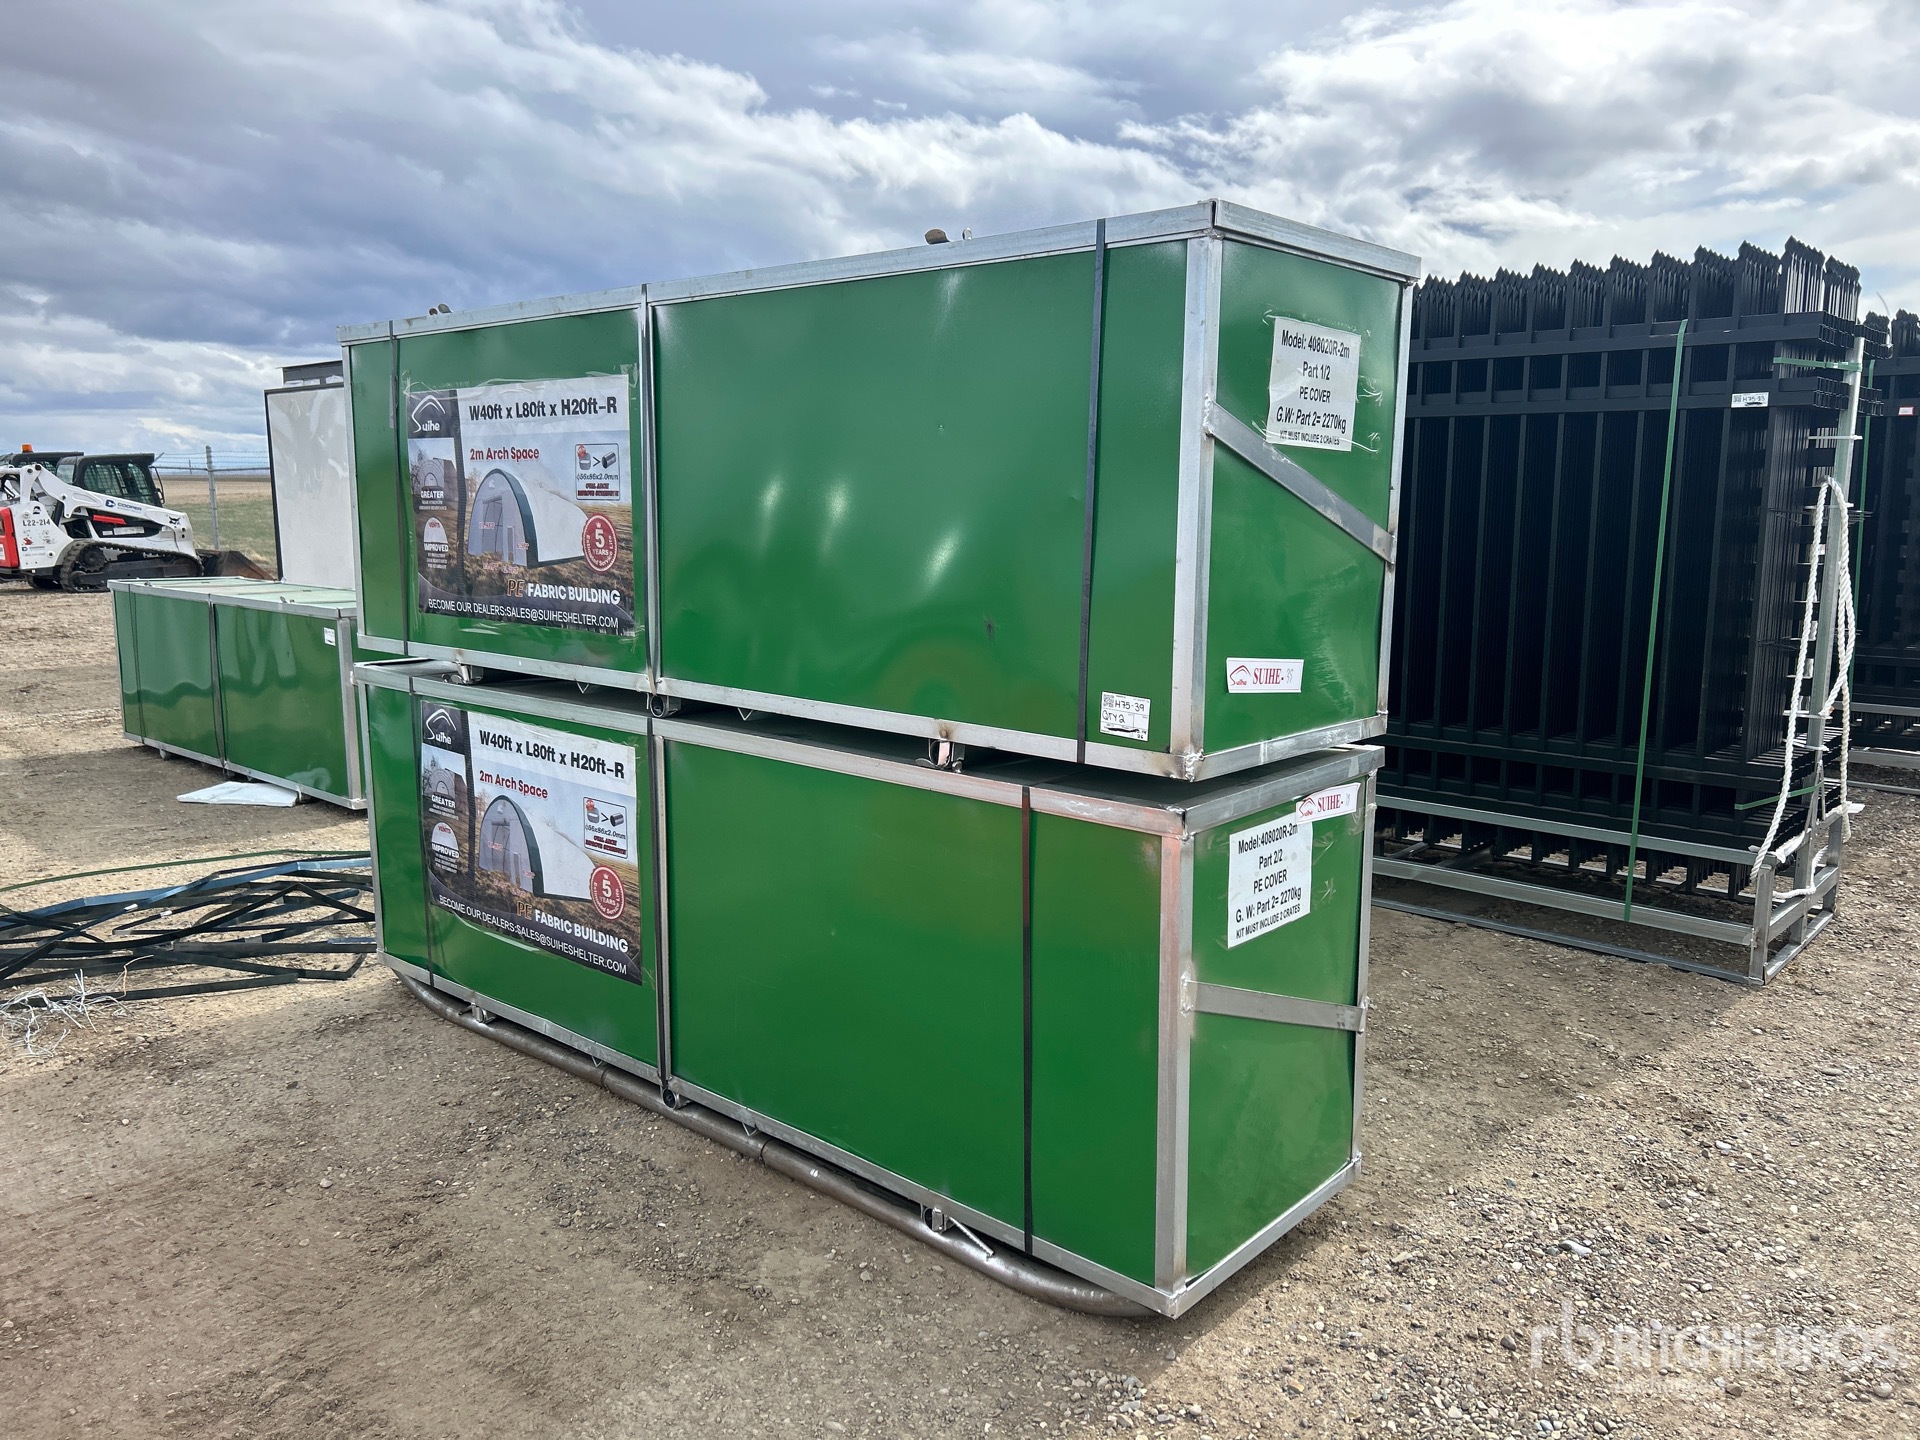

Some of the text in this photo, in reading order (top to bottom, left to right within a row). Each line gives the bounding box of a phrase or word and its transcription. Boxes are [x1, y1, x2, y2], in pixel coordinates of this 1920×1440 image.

[1282, 330, 1350, 358] Model: 408020R-2m
[1303, 362, 1331, 380] Part 1/2
[1300, 386, 1331, 403] PE COVER
[469, 396, 617, 421] W40ft x L80ft x H20ft-R
[1276, 406, 1346, 434] G.W: Part 2= 2270kg
[470, 446, 540, 463] 2m Arch Space
[118, 502, 142, 511] COOPER
[424, 543, 448, 551] IMPROVED
[595, 529, 605, 548] 5
[507, 579, 620, 605] PE FABRIC BUILDING
[428, 598, 455, 611] BECOME
[456, 601, 473, 613] OUR
[1115, 700, 1144, 712] H75-39
[479, 730, 624, 779] W40ft x L80ft x H20ft-R
[480, 770, 548, 799] 2m Arch Space
[432, 795, 455, 808] GREATER
[432, 843, 459, 858] IMPROVED
[1259, 849, 1283, 869] Part 2/2
[602, 879, 611, 897] 5
[1253, 869, 1287, 894] PE COVER
[439, 895, 466, 914] BECOME
[466, 906, 482, 919] OUR
[600, 896, 616, 906] YEARS
[1236, 887, 1301, 923] G. W: Part 2= 2270kg
[517, 901, 628, 952] PE FABRIC BUILDING
[1236, 903, 1300, 939] KIT MUST INCLUDE 2 CRATES
